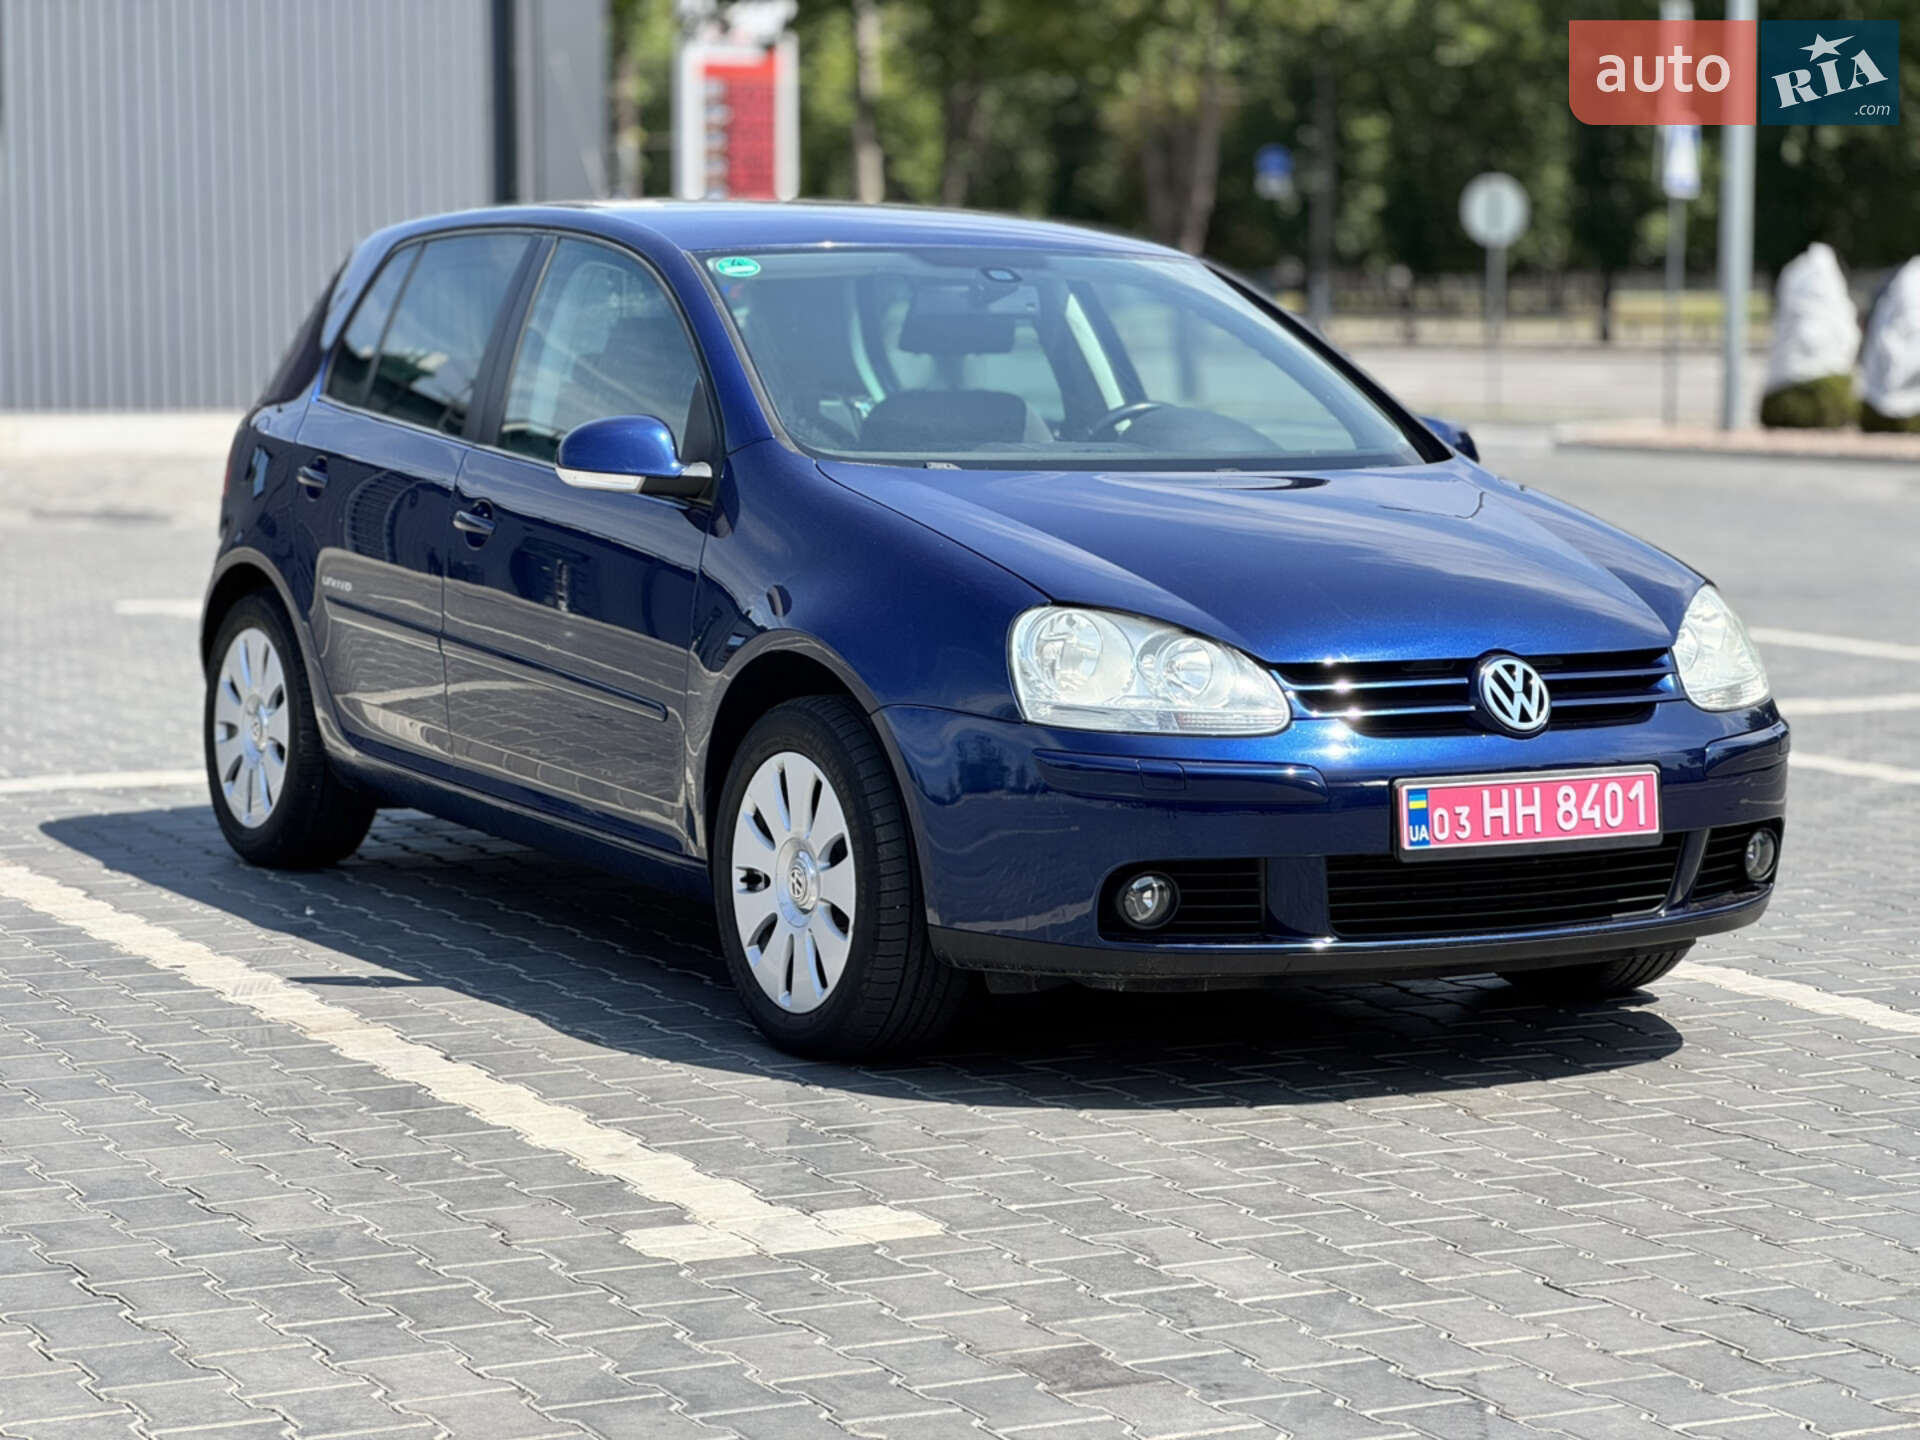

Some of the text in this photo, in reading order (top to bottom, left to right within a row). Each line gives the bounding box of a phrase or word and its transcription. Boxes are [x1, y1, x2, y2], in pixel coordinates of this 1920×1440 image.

[1432, 779, 1646, 841] 03 HH 8401
[1409, 824, 1429, 841] UA
